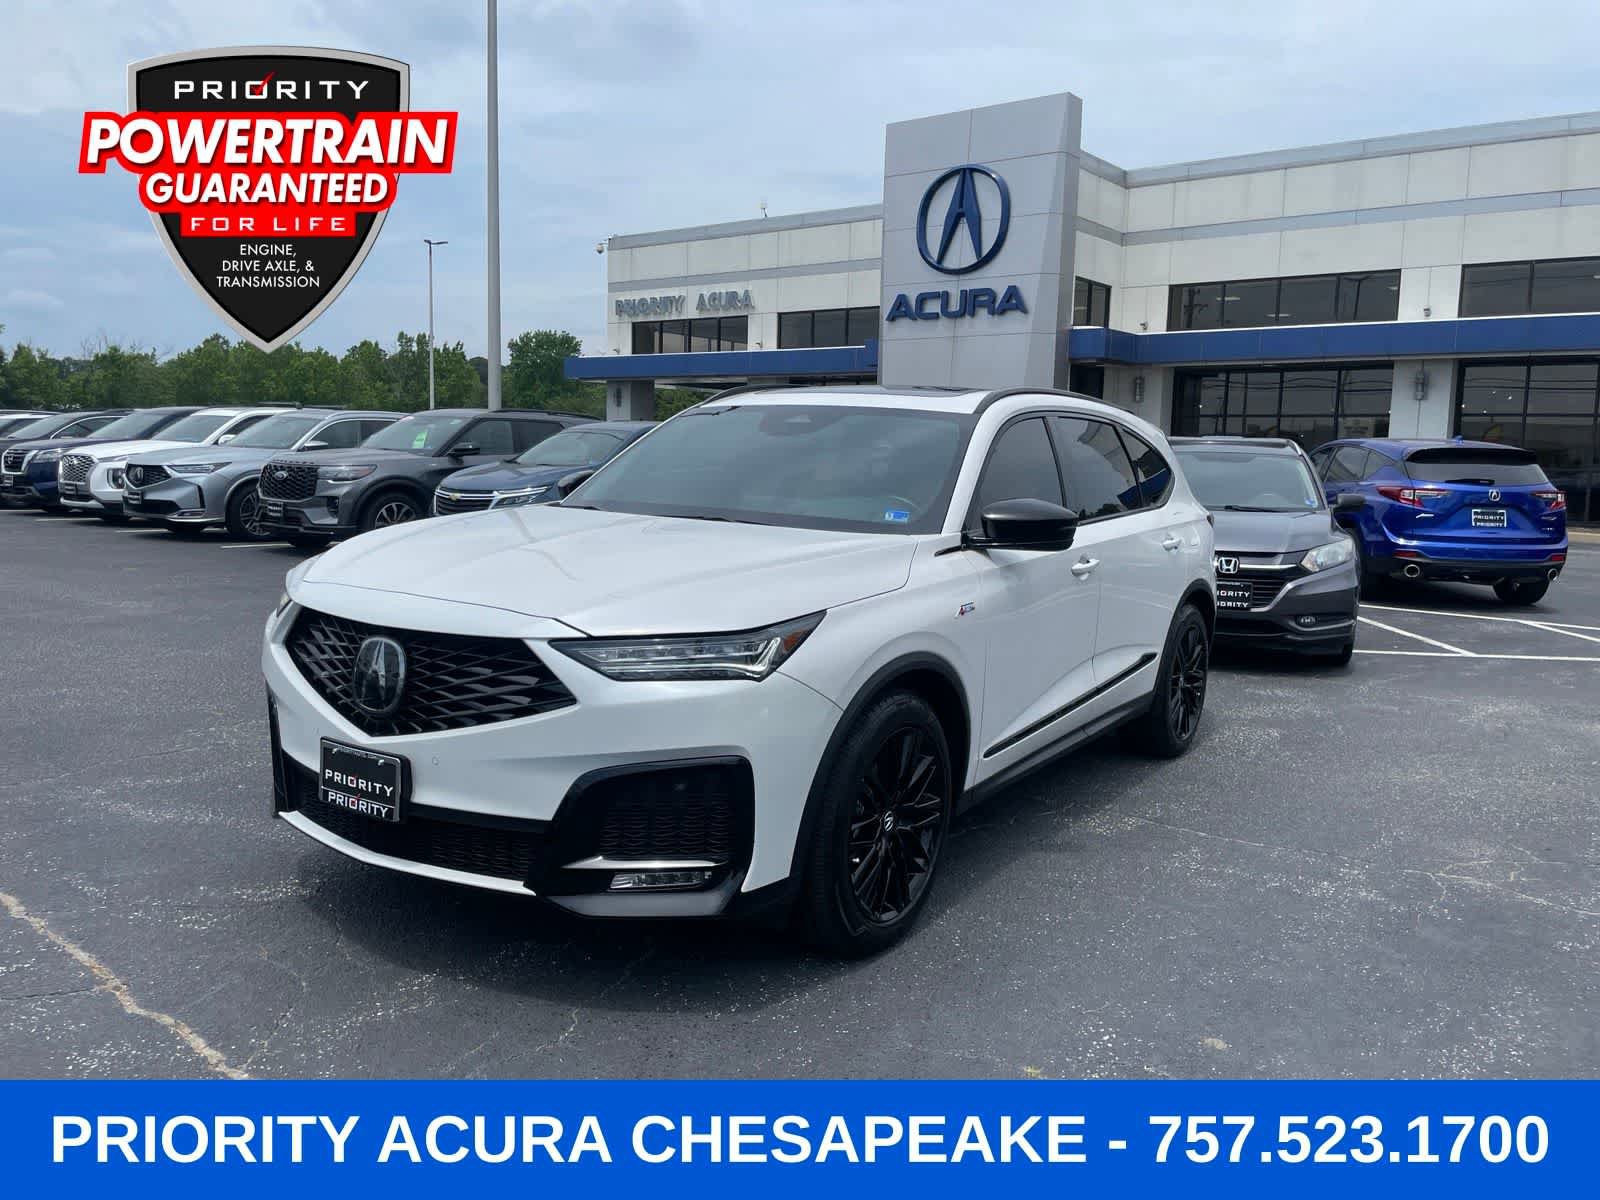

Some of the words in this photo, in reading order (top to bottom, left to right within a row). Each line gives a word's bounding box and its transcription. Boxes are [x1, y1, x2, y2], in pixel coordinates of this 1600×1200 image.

[615, 295, 686, 317] PRIORITY
[695, 289, 756, 312] ACURA
[885, 284, 1029, 322] ACURA
[1216, 590, 1250, 598] IORITY
[325, 768, 394, 797] PRIORITY
[328, 791, 388, 818] PRIORITY
